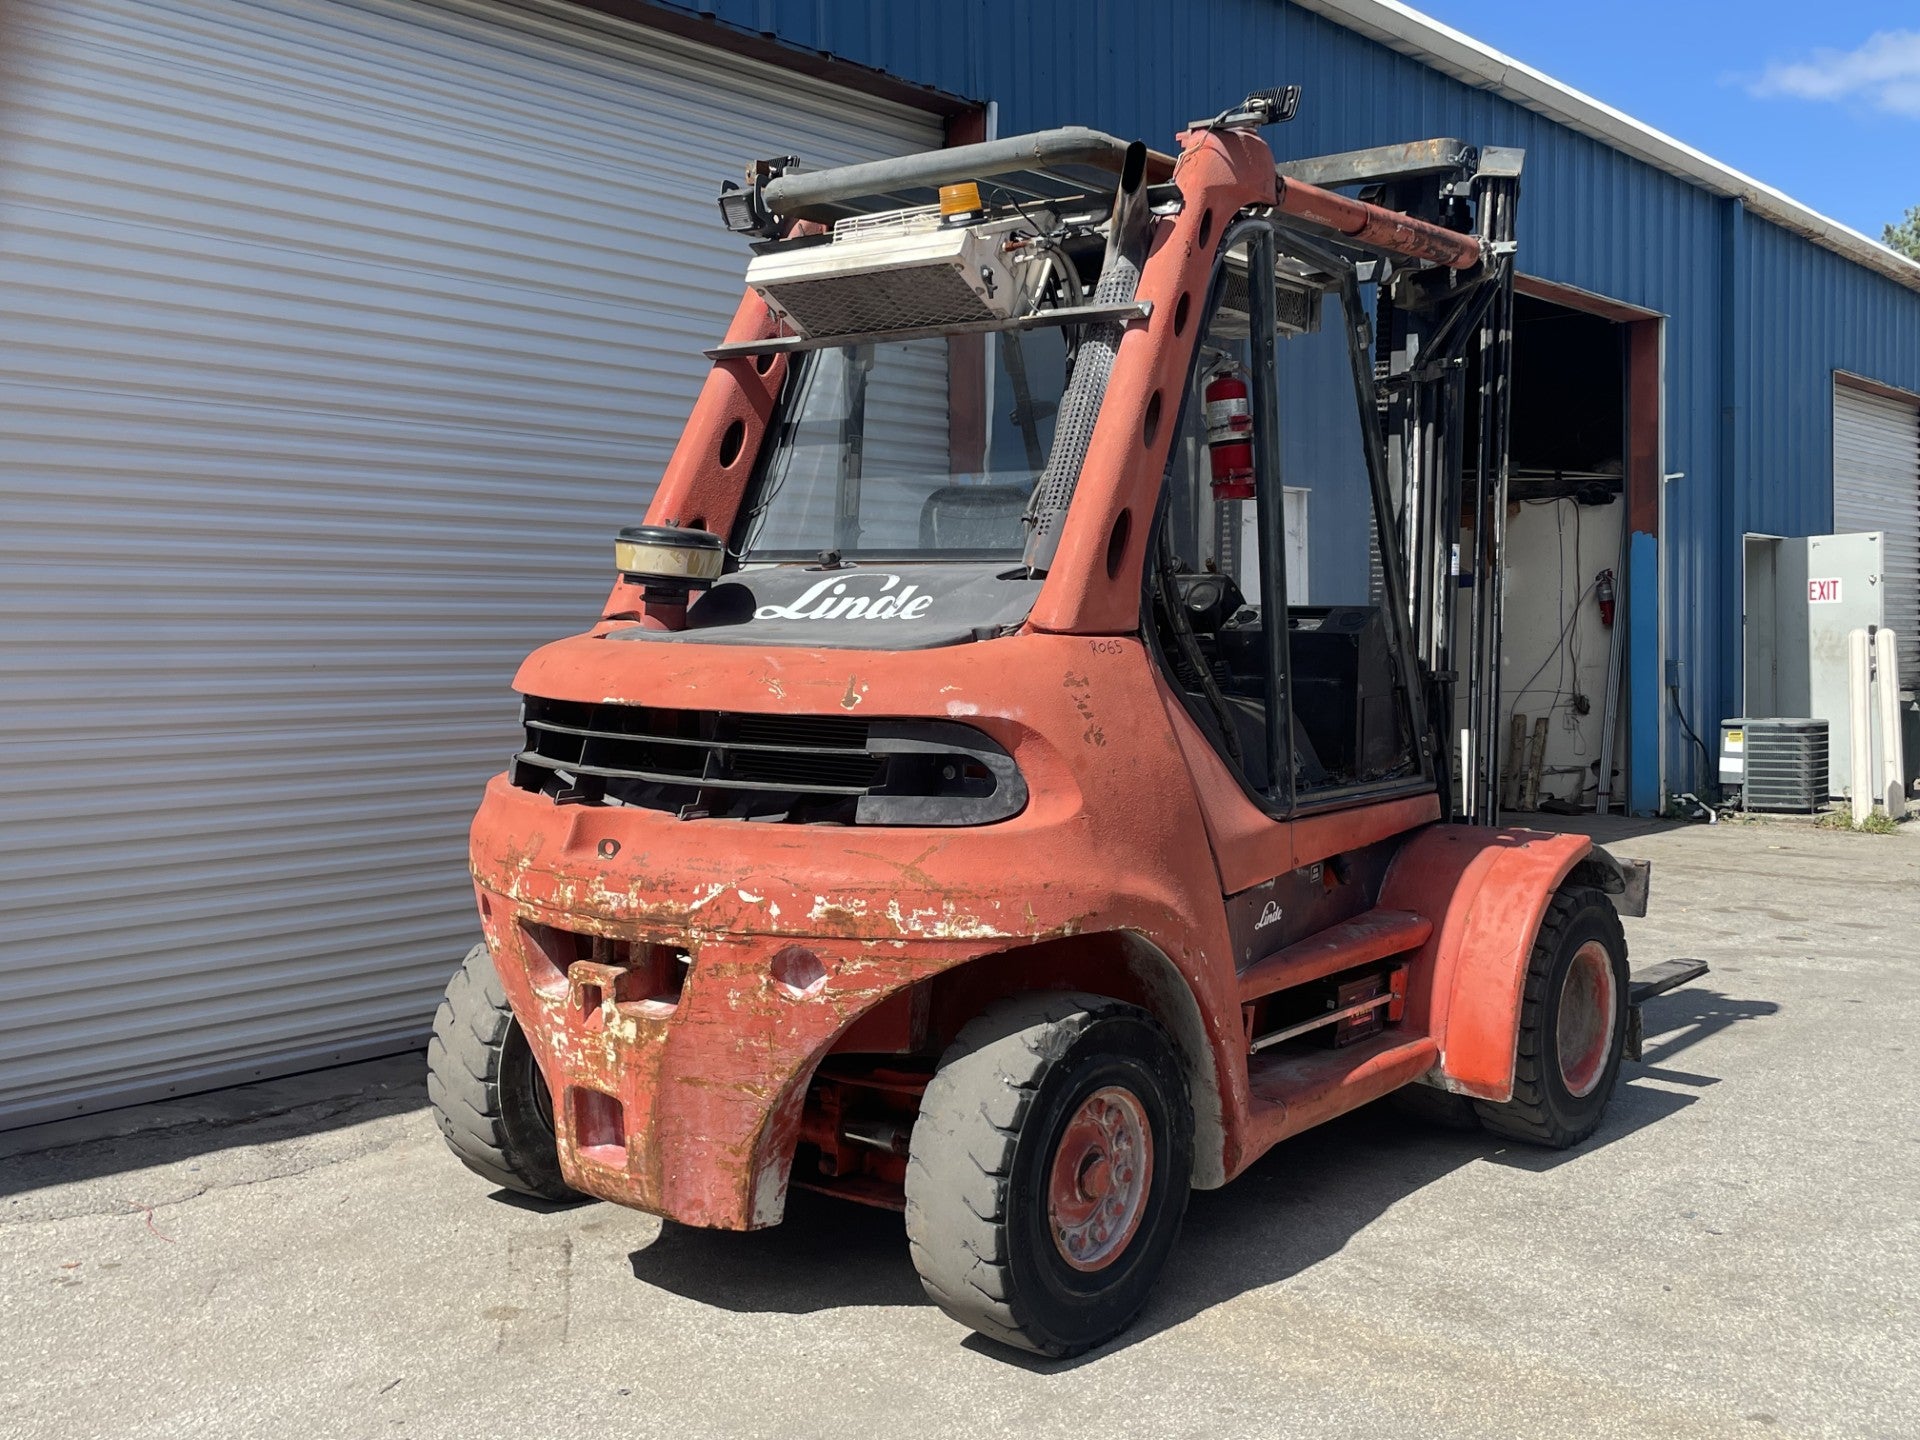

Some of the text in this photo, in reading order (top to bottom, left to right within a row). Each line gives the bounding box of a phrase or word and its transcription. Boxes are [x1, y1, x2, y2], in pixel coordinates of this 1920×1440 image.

[753, 573, 933, 620] Linde
[1809, 580, 1839, 601] EXIT
[1254, 900, 1283, 930] Linde
